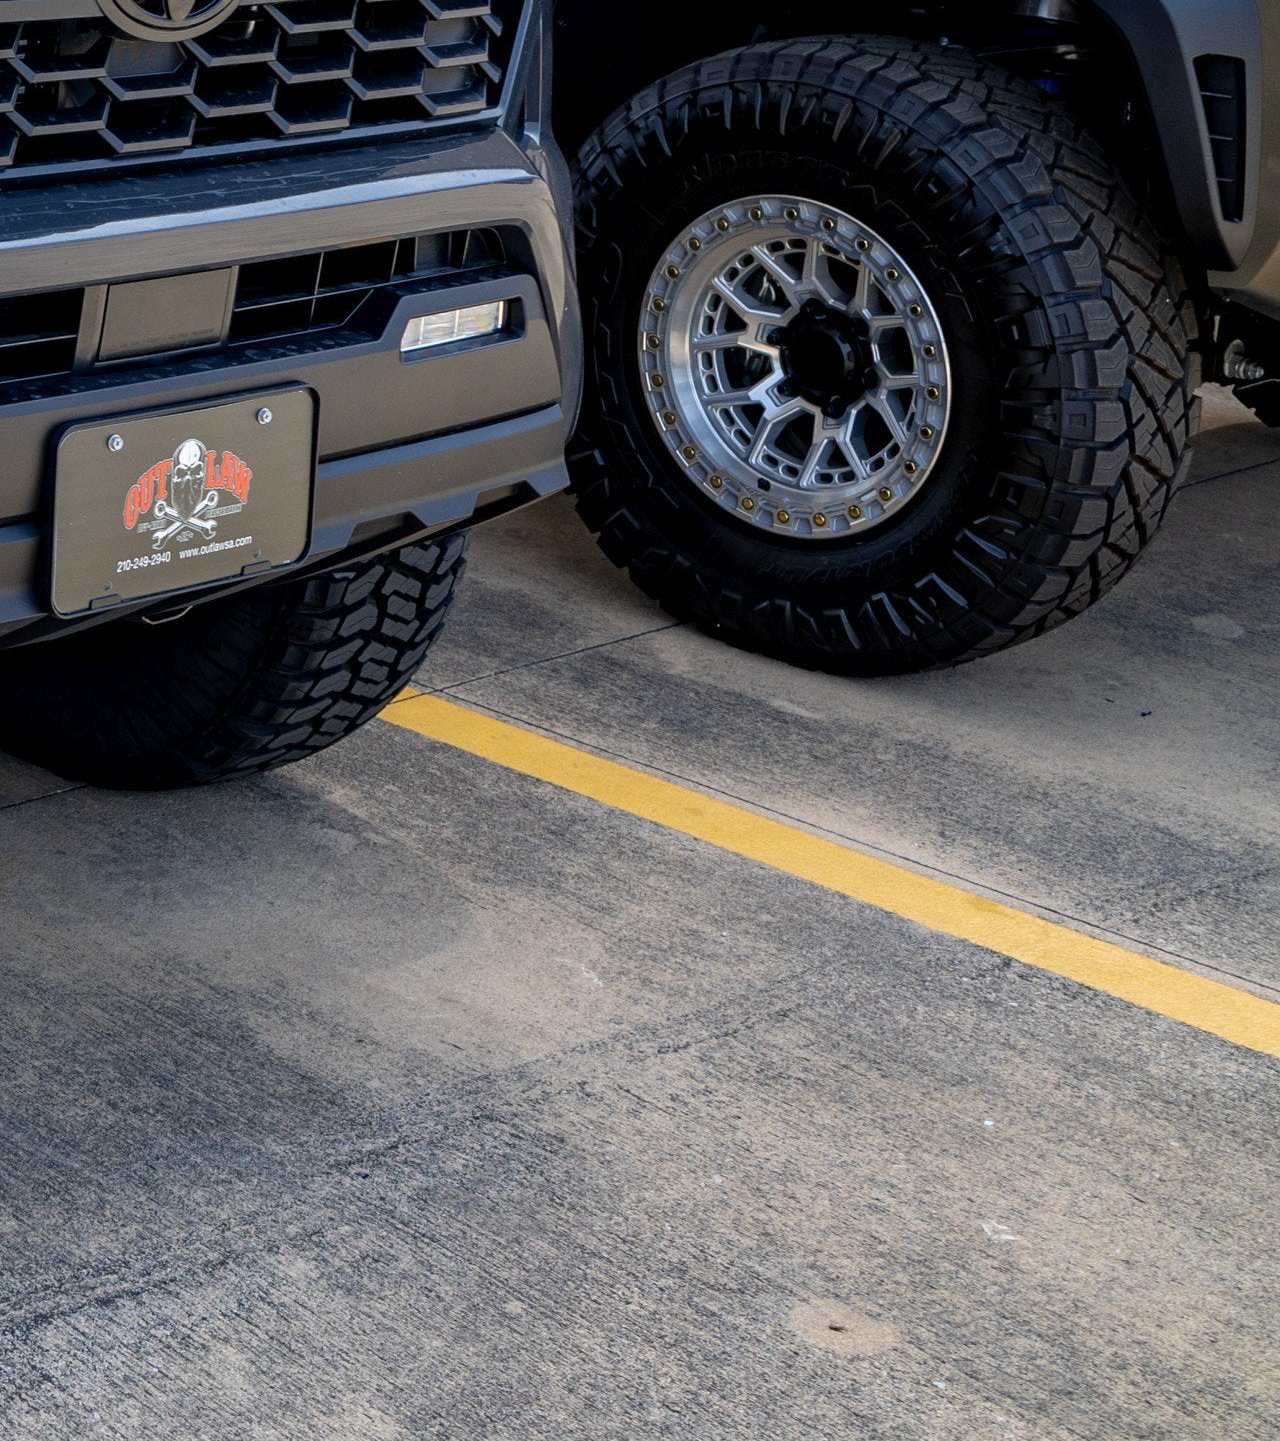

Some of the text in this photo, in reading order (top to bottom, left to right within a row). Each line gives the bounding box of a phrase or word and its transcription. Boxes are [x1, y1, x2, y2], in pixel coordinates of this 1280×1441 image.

[124, 450, 252, 529] OUT LAW
[179, 535, 252, 559] www.outlawsa.com
